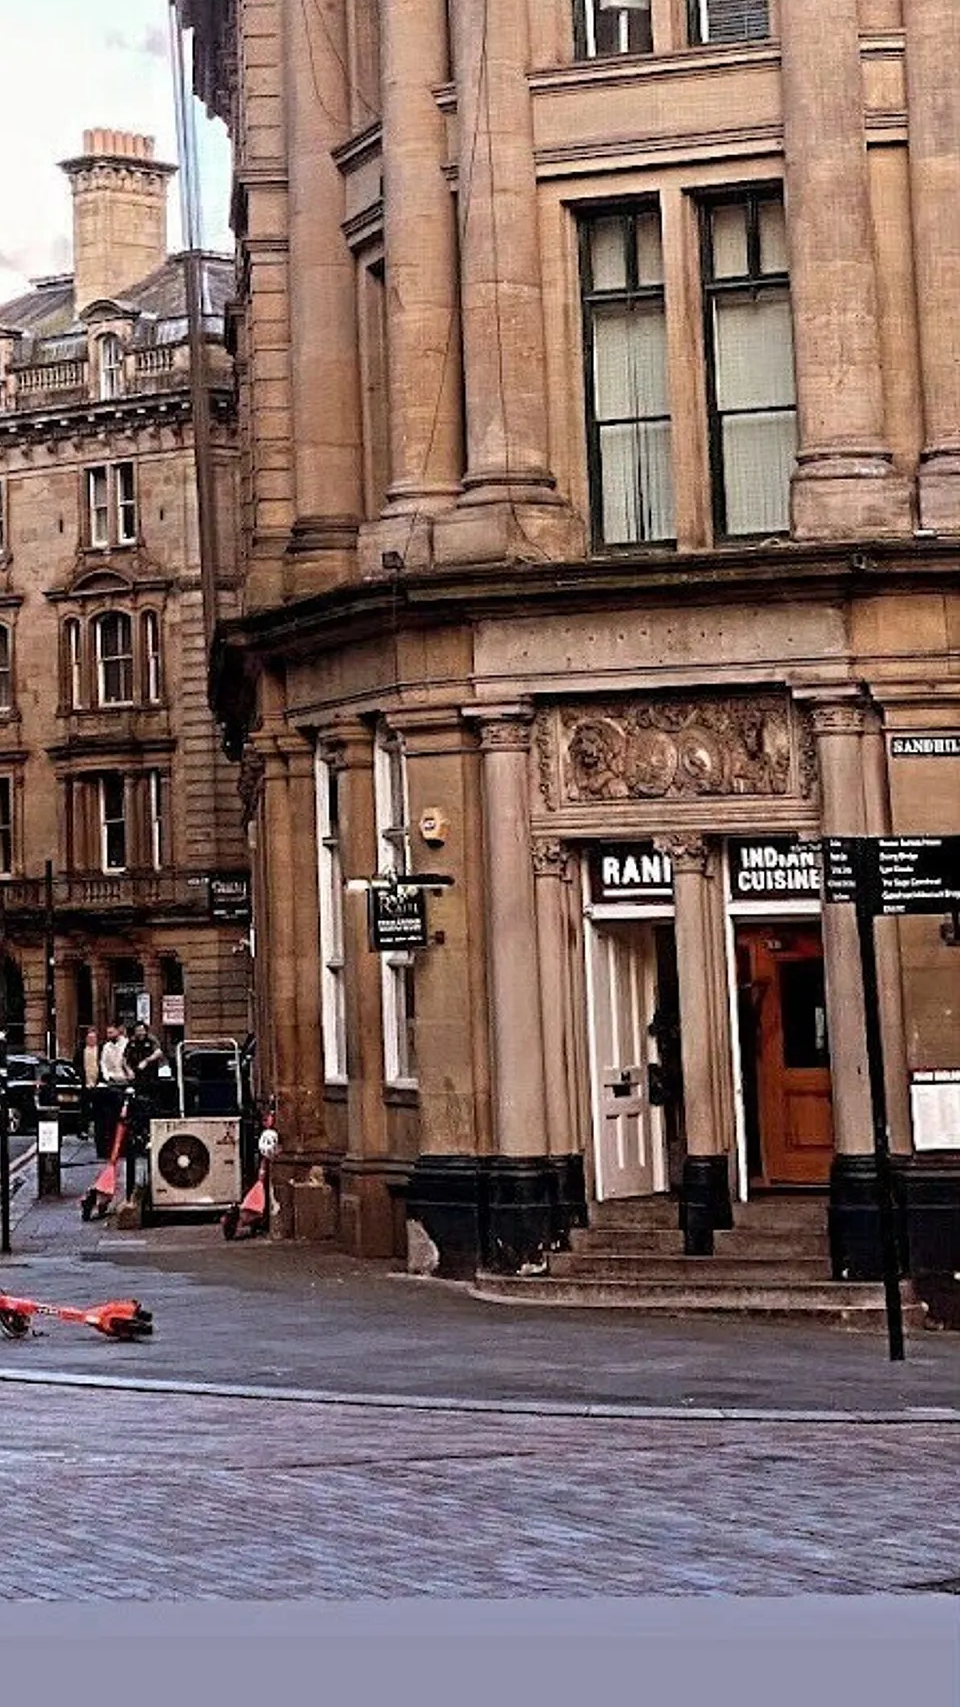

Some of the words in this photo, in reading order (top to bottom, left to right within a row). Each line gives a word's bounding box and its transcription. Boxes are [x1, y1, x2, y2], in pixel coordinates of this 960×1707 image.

[893, 739, 960, 753] SANDHIL
[740, 846, 814, 868] INDIAN
[603, 855, 671, 885] RANI
[738, 869, 821, 891] CUISINE
